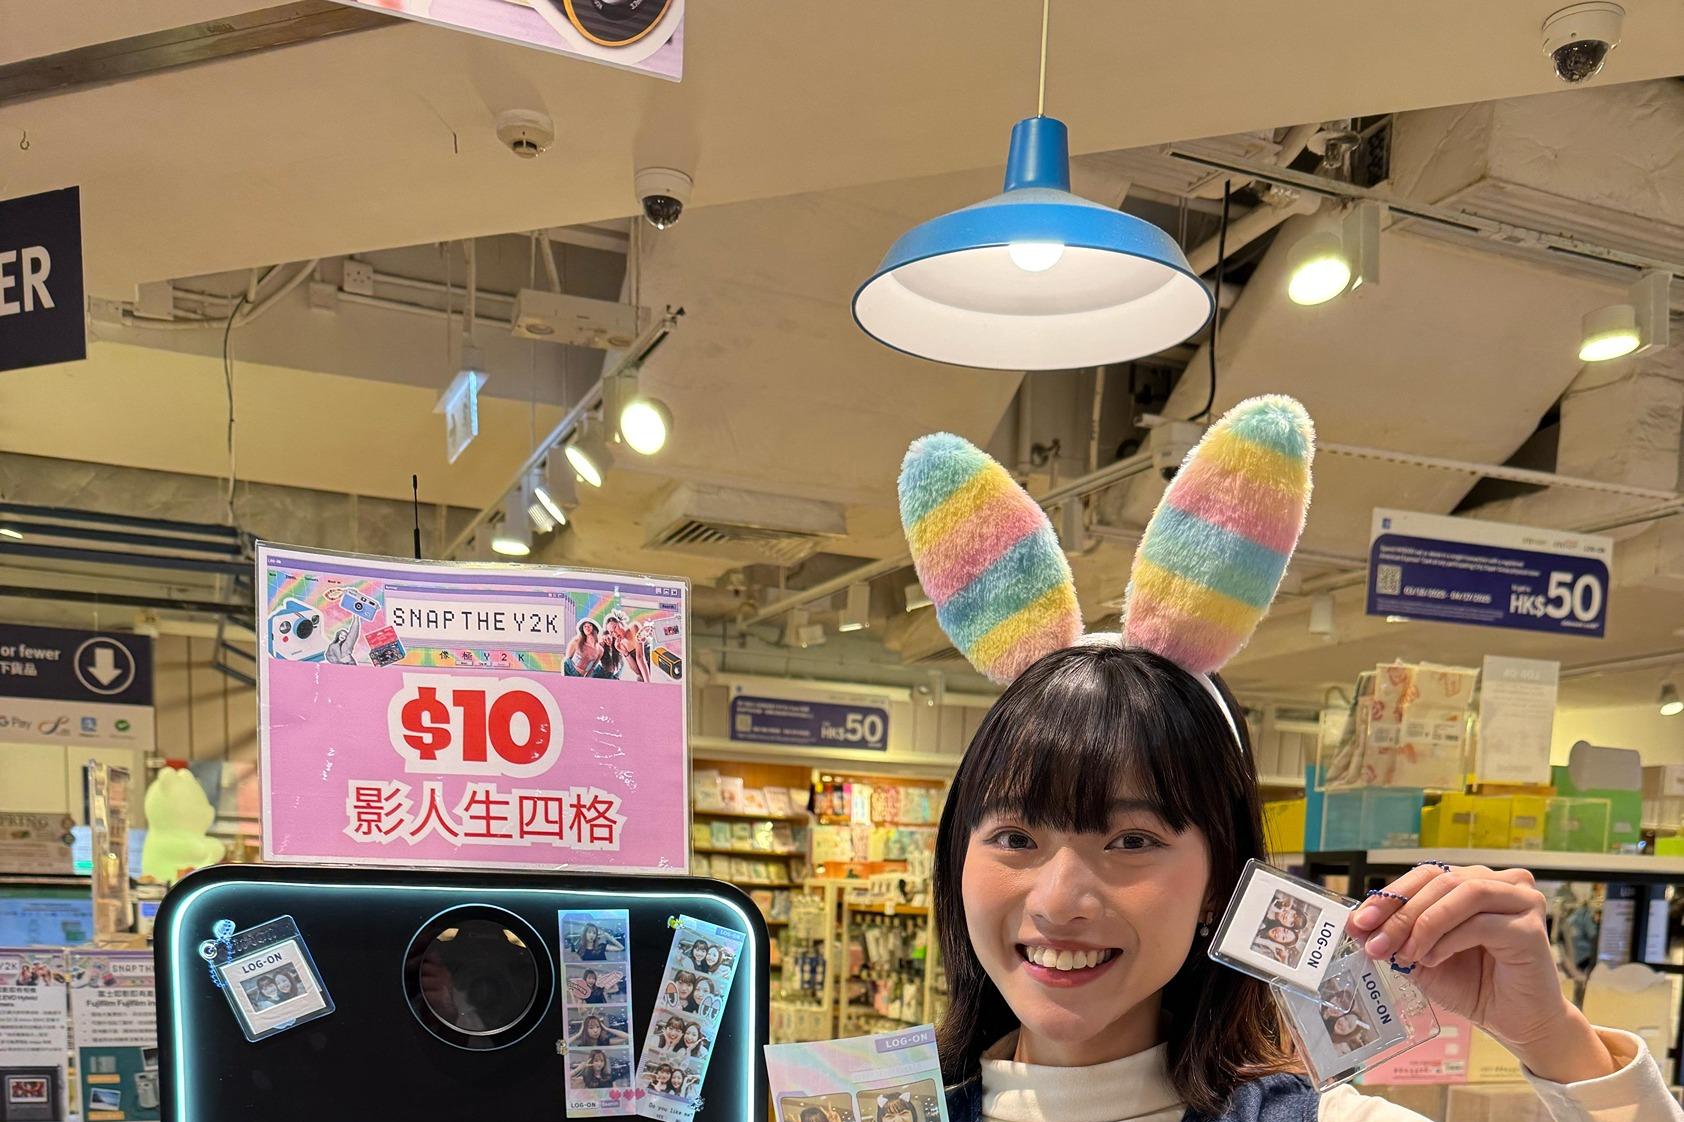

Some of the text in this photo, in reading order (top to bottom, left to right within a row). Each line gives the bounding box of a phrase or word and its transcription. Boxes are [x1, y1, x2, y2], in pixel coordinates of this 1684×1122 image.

[0, 644, 61, 660] or fewer
[400, 686, 551, 765] $10
[352, 786, 618, 845] 影人生四格
[241, 952, 283, 974] LOG-ON
[1307, 921, 1336, 969] LOG-ON
[1361, 972, 1392, 1025] LOG-ON
[886, 1033, 928, 1050] LOG-ON
